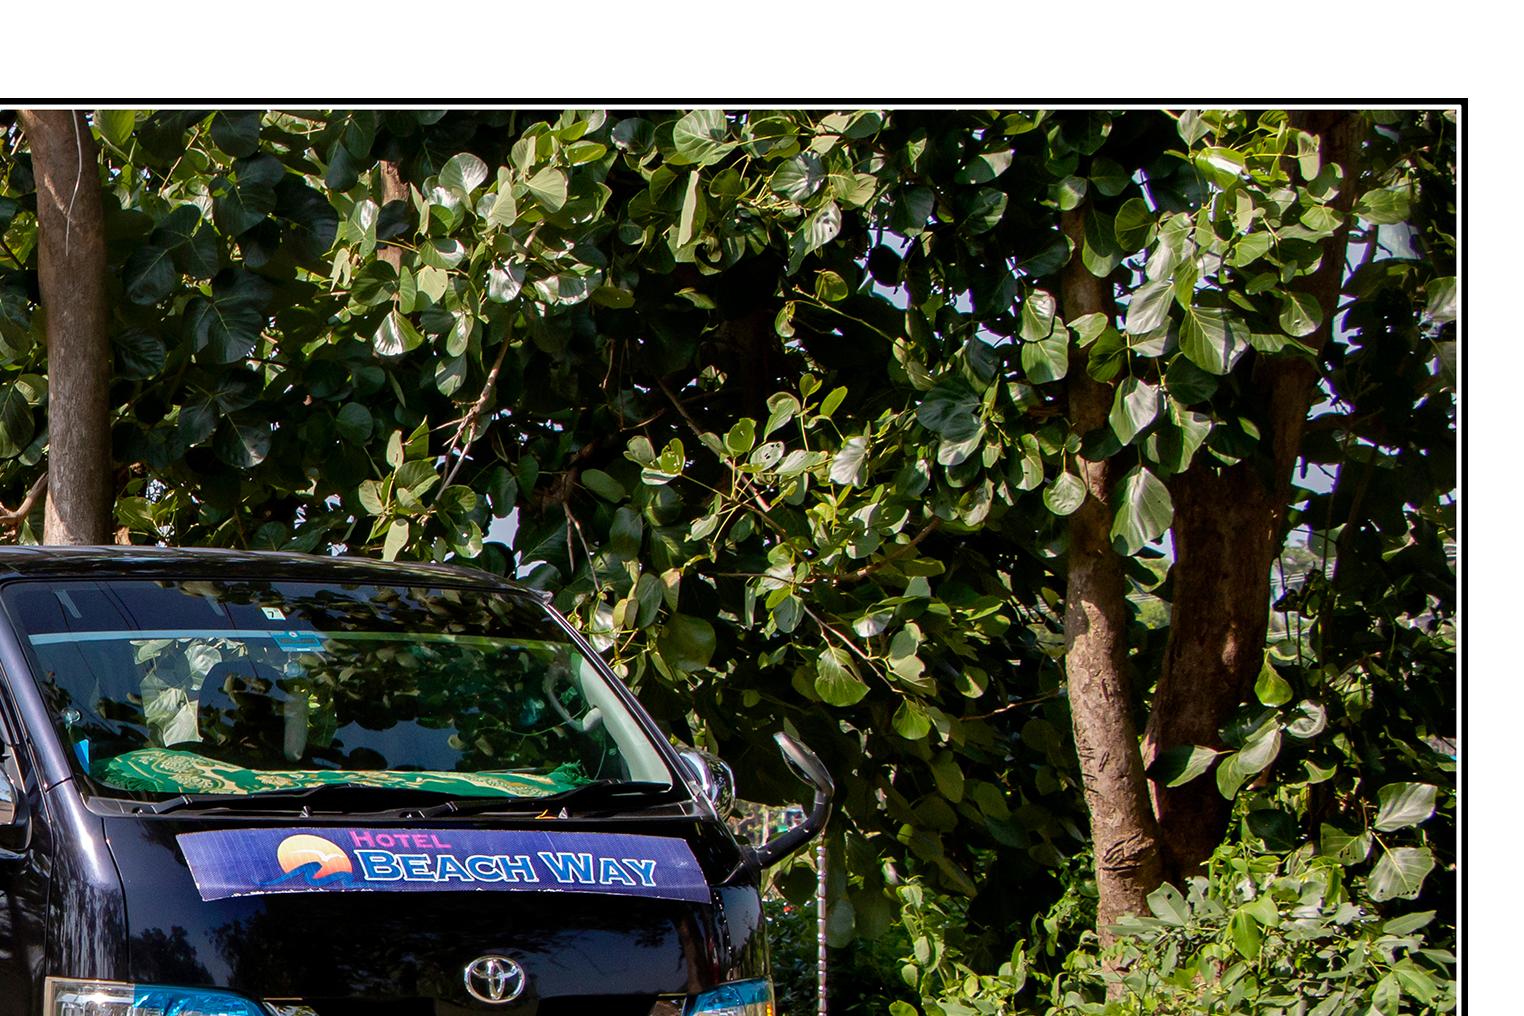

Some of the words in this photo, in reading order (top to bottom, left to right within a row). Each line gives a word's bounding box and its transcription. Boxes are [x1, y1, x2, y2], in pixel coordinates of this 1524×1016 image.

[349, 830, 452, 849] HOTEL
[354, 849, 540, 883] BEACH
[537, 851, 657, 886] WAY
